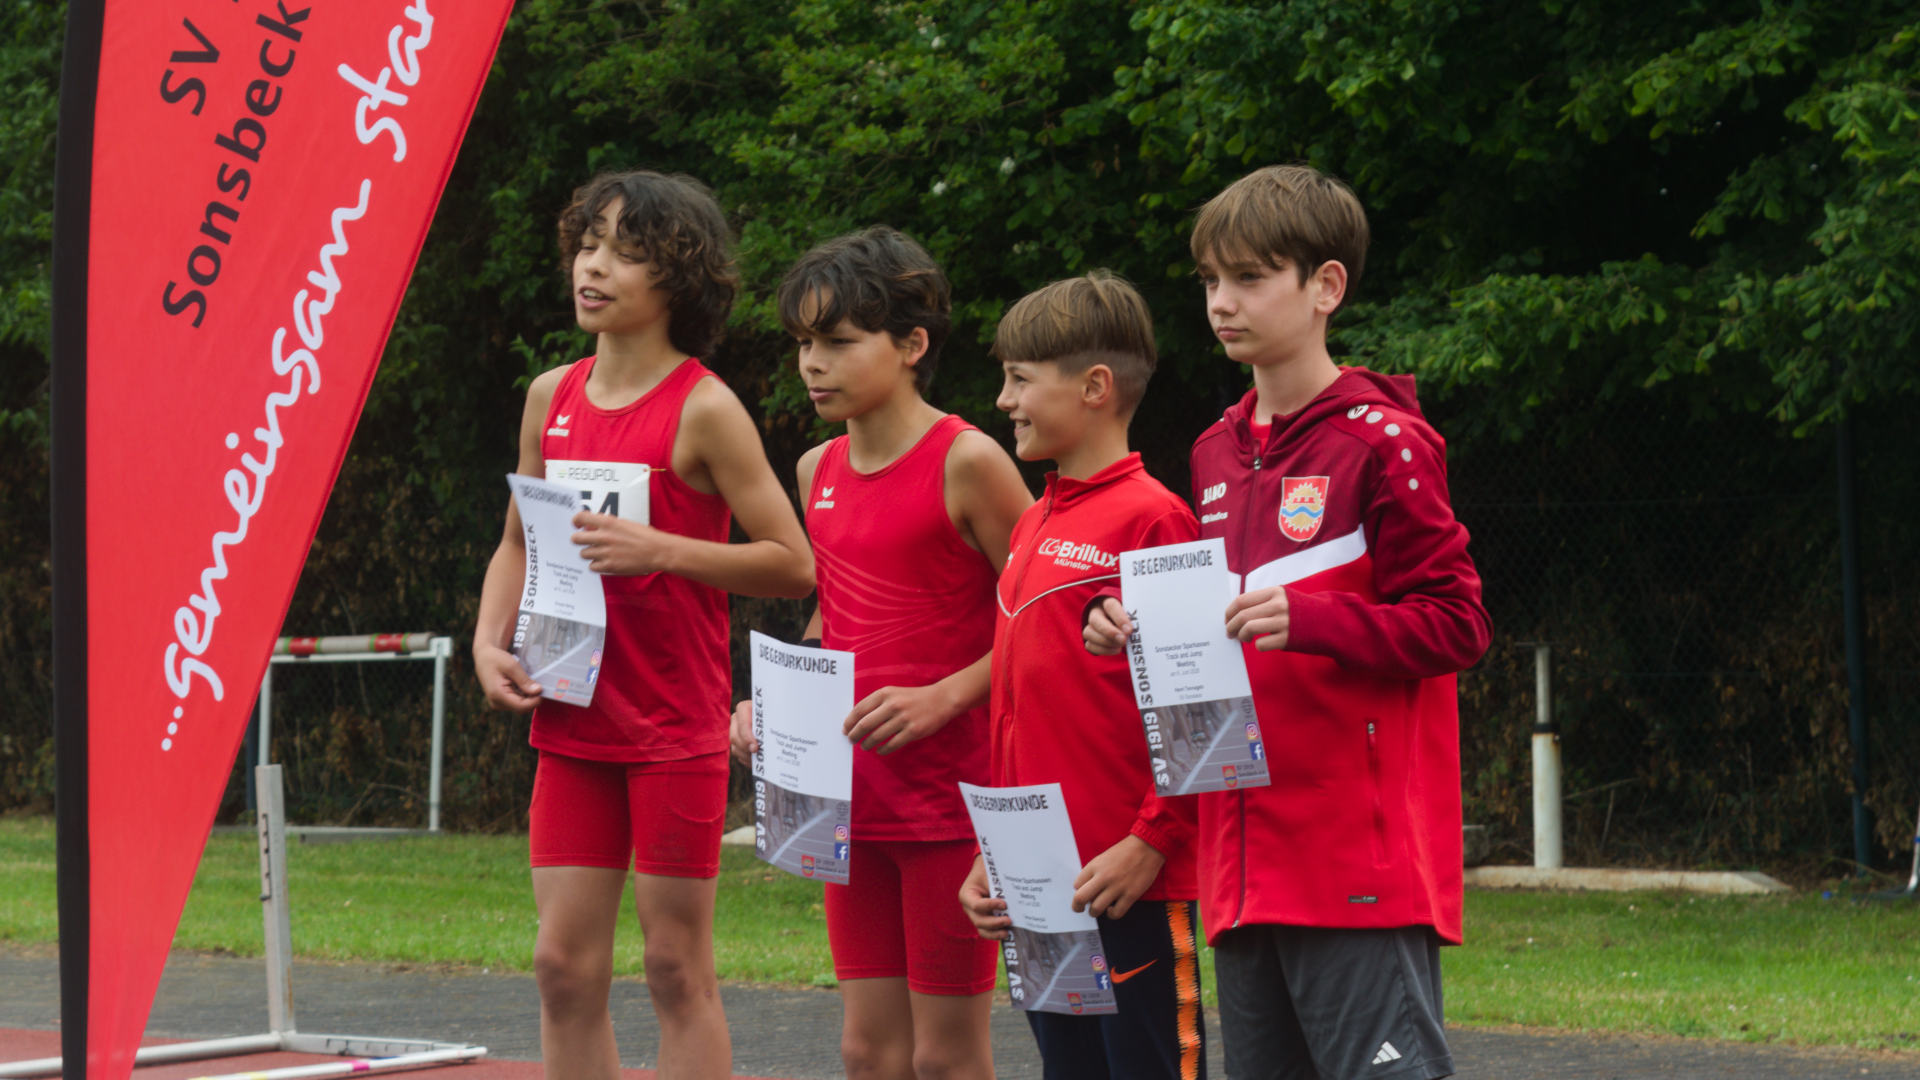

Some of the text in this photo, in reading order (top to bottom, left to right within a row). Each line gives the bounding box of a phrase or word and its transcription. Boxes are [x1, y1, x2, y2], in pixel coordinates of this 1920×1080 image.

[160, 17, 220, 117] SV
[162, 0, 312, 329] Sonsbeck
[567, 467, 620, 481] REGUPOL
[1054, 558, 1092, 571] Münster
[1132, 549, 1213, 576] SIEGERURKUNDE
[1127, 609, 1170, 787] SV 1919 SONSBECK
[755, 780, 767, 817] 1919
[756, 822, 767, 851] SV
[1008, 971, 1024, 1001] SV
